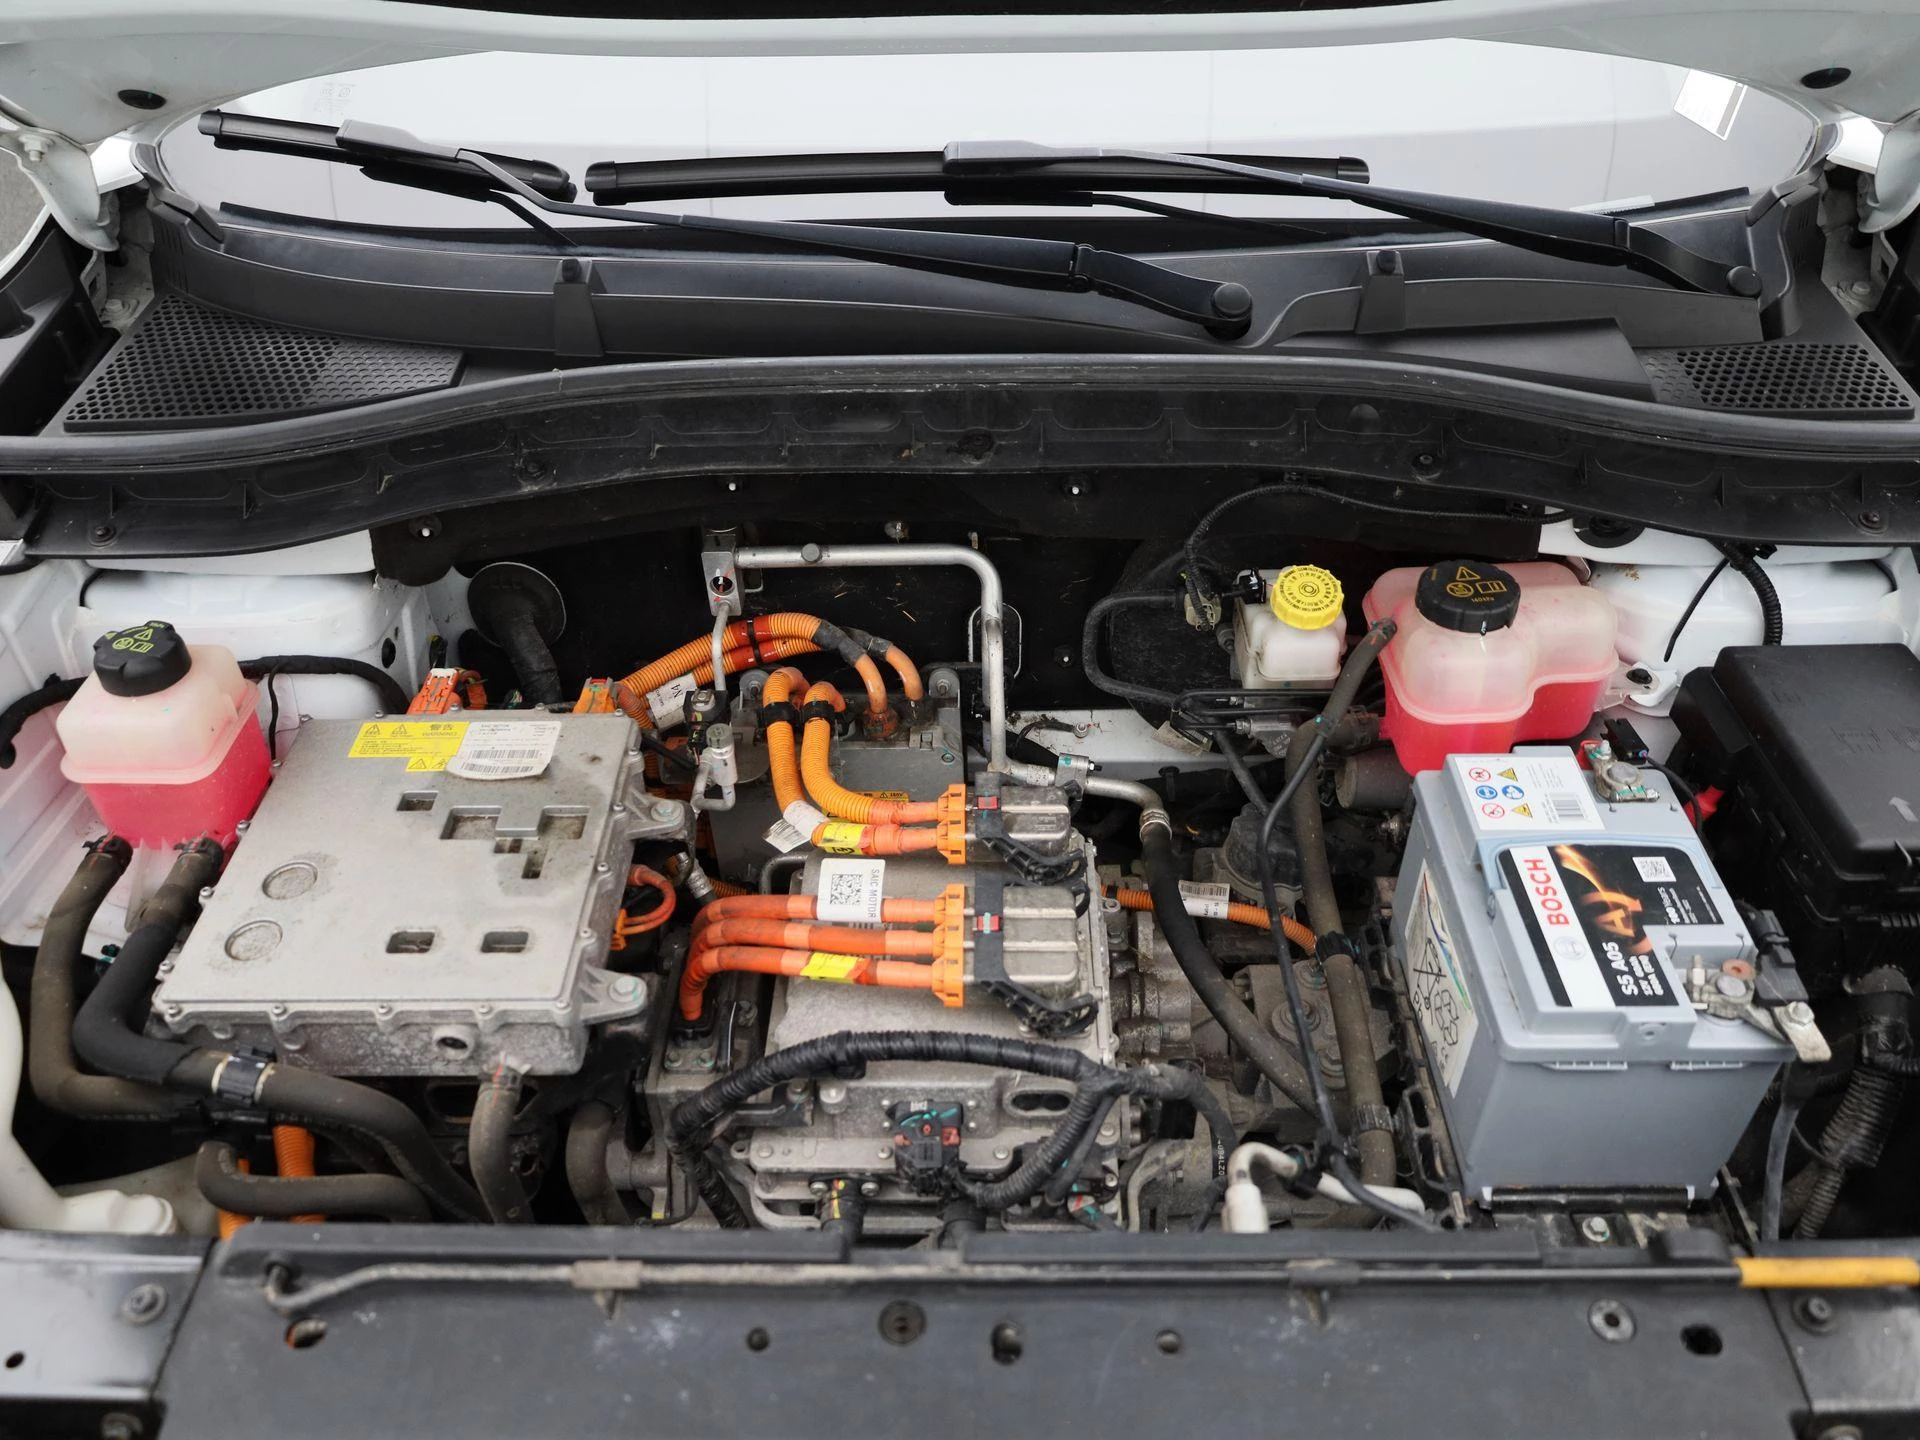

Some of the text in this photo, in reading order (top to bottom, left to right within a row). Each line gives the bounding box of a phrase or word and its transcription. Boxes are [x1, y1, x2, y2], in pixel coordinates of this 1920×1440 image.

[867, 867, 880, 918] SAIC MOTOR
[1523, 859, 1570, 925] BOSCH
[1602, 941, 1629, 972] A05
[1616, 974, 1639, 996] S5
